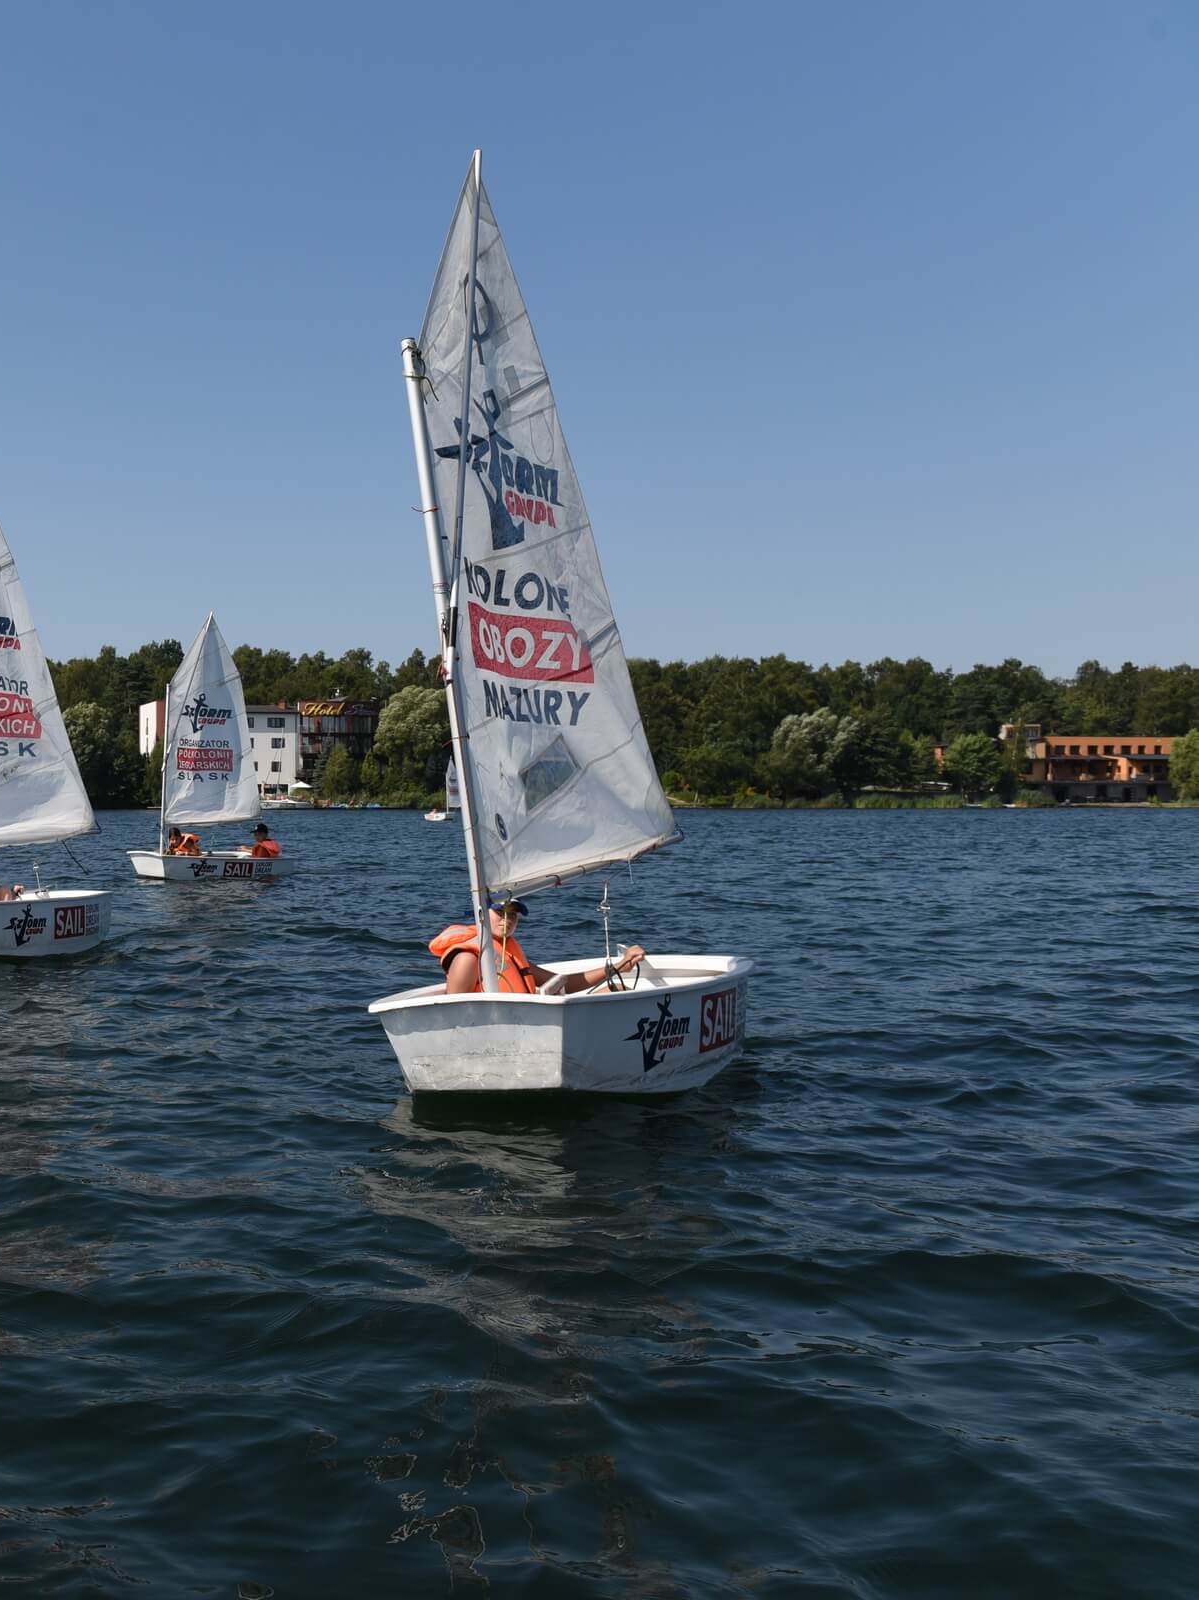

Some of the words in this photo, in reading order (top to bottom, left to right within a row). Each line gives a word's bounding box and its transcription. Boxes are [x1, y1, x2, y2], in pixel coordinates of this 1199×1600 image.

[464, 556, 571, 621] KOLONE
[479, 617, 582, 671] OBOZY
[302, 702, 345, 716] Hotel
[483, 679, 590, 726] MAZURY
[225, 863, 251, 877] SAIL
[56, 908, 83, 936] SAIL
[702, 995, 735, 1047] SAIL
